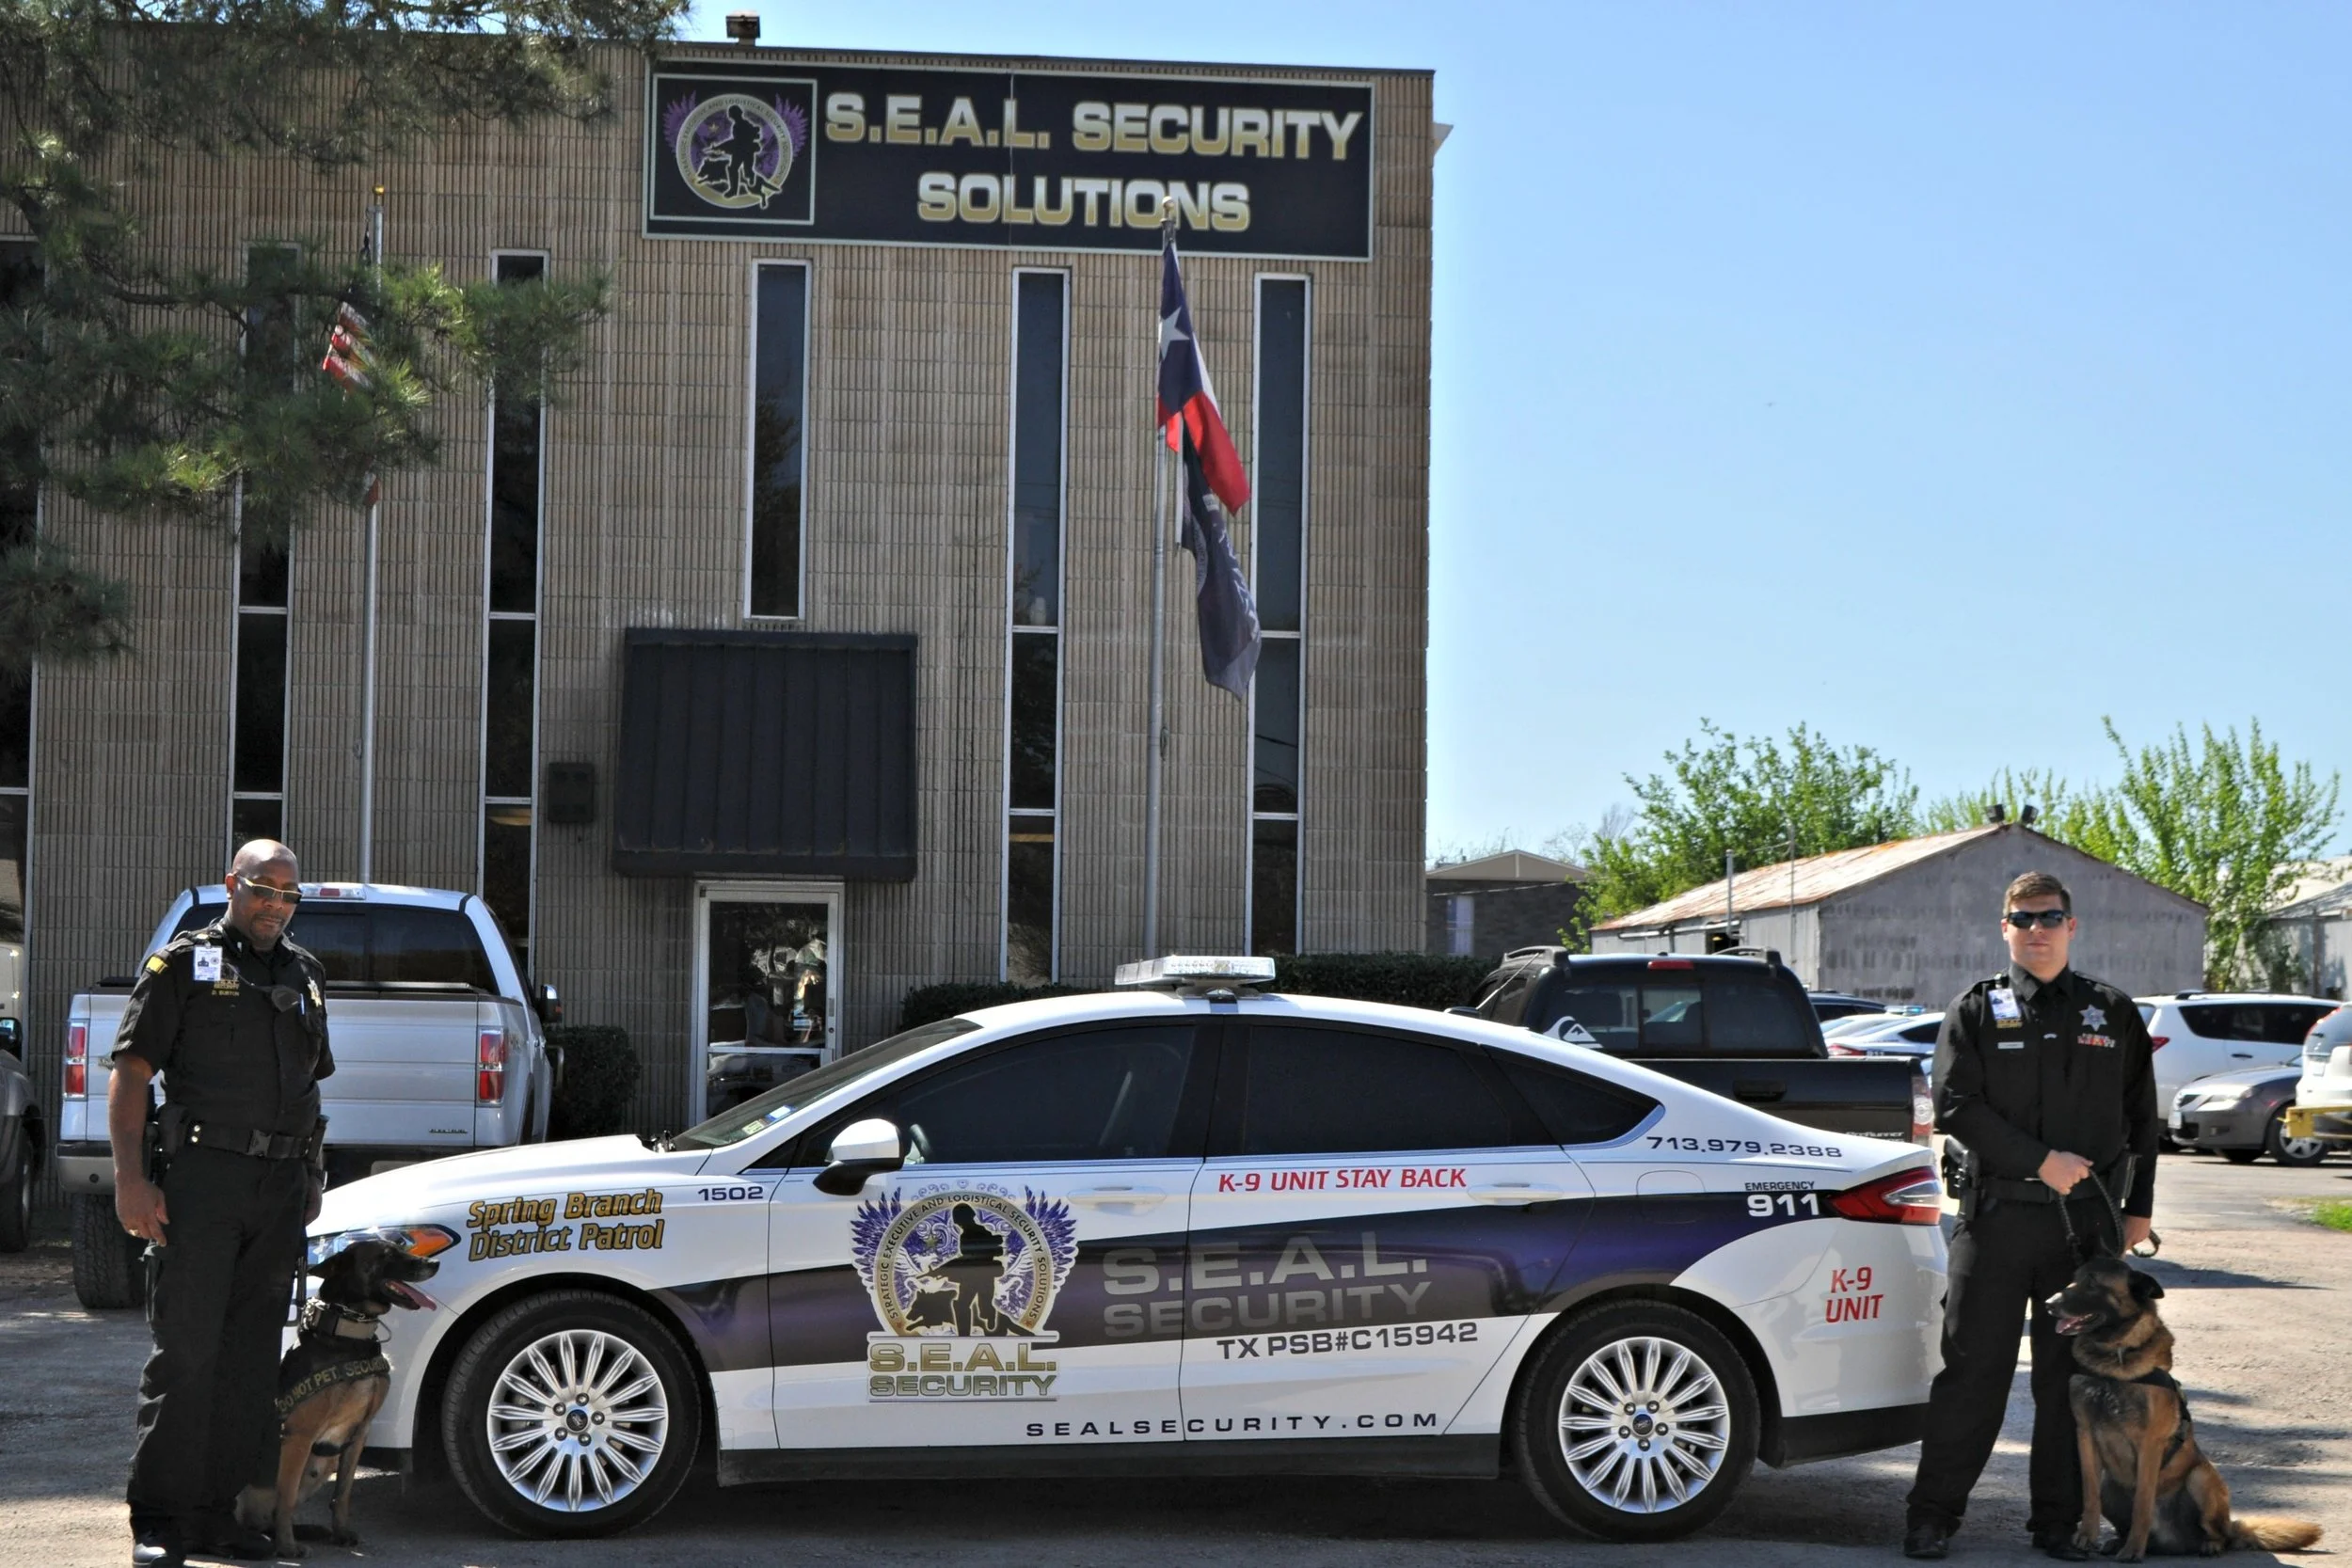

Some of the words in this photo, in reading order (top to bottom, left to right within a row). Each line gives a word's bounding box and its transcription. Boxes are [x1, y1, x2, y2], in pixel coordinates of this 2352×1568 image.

[825, 92, 1050, 149] S.E.A.L.
[1073, 101, 1362, 160] SECURITY
[917, 171, 1250, 232] SOLUTIONS
[1646, 1136, 1843, 1158] 713.979.2388
[697, 1185, 764, 1201] 1502
[1218, 1173, 1261, 1192] K-9
[1271, 1170, 1329, 1191] UNIT
[1335, 1169, 1391, 1189] STAY
[1400, 1168, 1467, 1188] BACK
[1745, 1180, 1815, 1192] EMERGENCY
[467, 1196, 558, 1231] Spring
[564, 1188, 663, 1221] Branch
[921, 1196, 945, 1212] AND
[947, 1194, 1008, 1213] LOGISTICAL
[1747, 1193, 1820, 1217] 911
[469, 1225, 572, 1262] District
[579, 1219, 665, 1251] Patrol
[885, 1211, 920, 1259] EXECUTIVE
[1009, 1210, 1042, 1254] SECURITY
[1103, 1231, 1428, 1296] S.E.A.L.
[880, 1262, 898, 1319] STRATEGIC
[1028, 1257, 1047, 1319] SOLUTIONS
[1831, 1267, 1872, 1293] K-9
[1104, 1282, 1433, 1338] SECURITY
[1825, 1294, 1883, 1323] UNIT
[869, 1342, 1057, 1372] S.E.A.L.
[1216, 1338, 1261, 1360] TX
[1267, 1322, 1478, 1356] PSB#C15942
[292, 1378, 312, 1401] NOT
[314, 1366, 338, 1386] PET
[869, 1375, 1057, 1397] SECURITY
[1026, 1413, 1437, 1437] SEALSECURITY.COM
